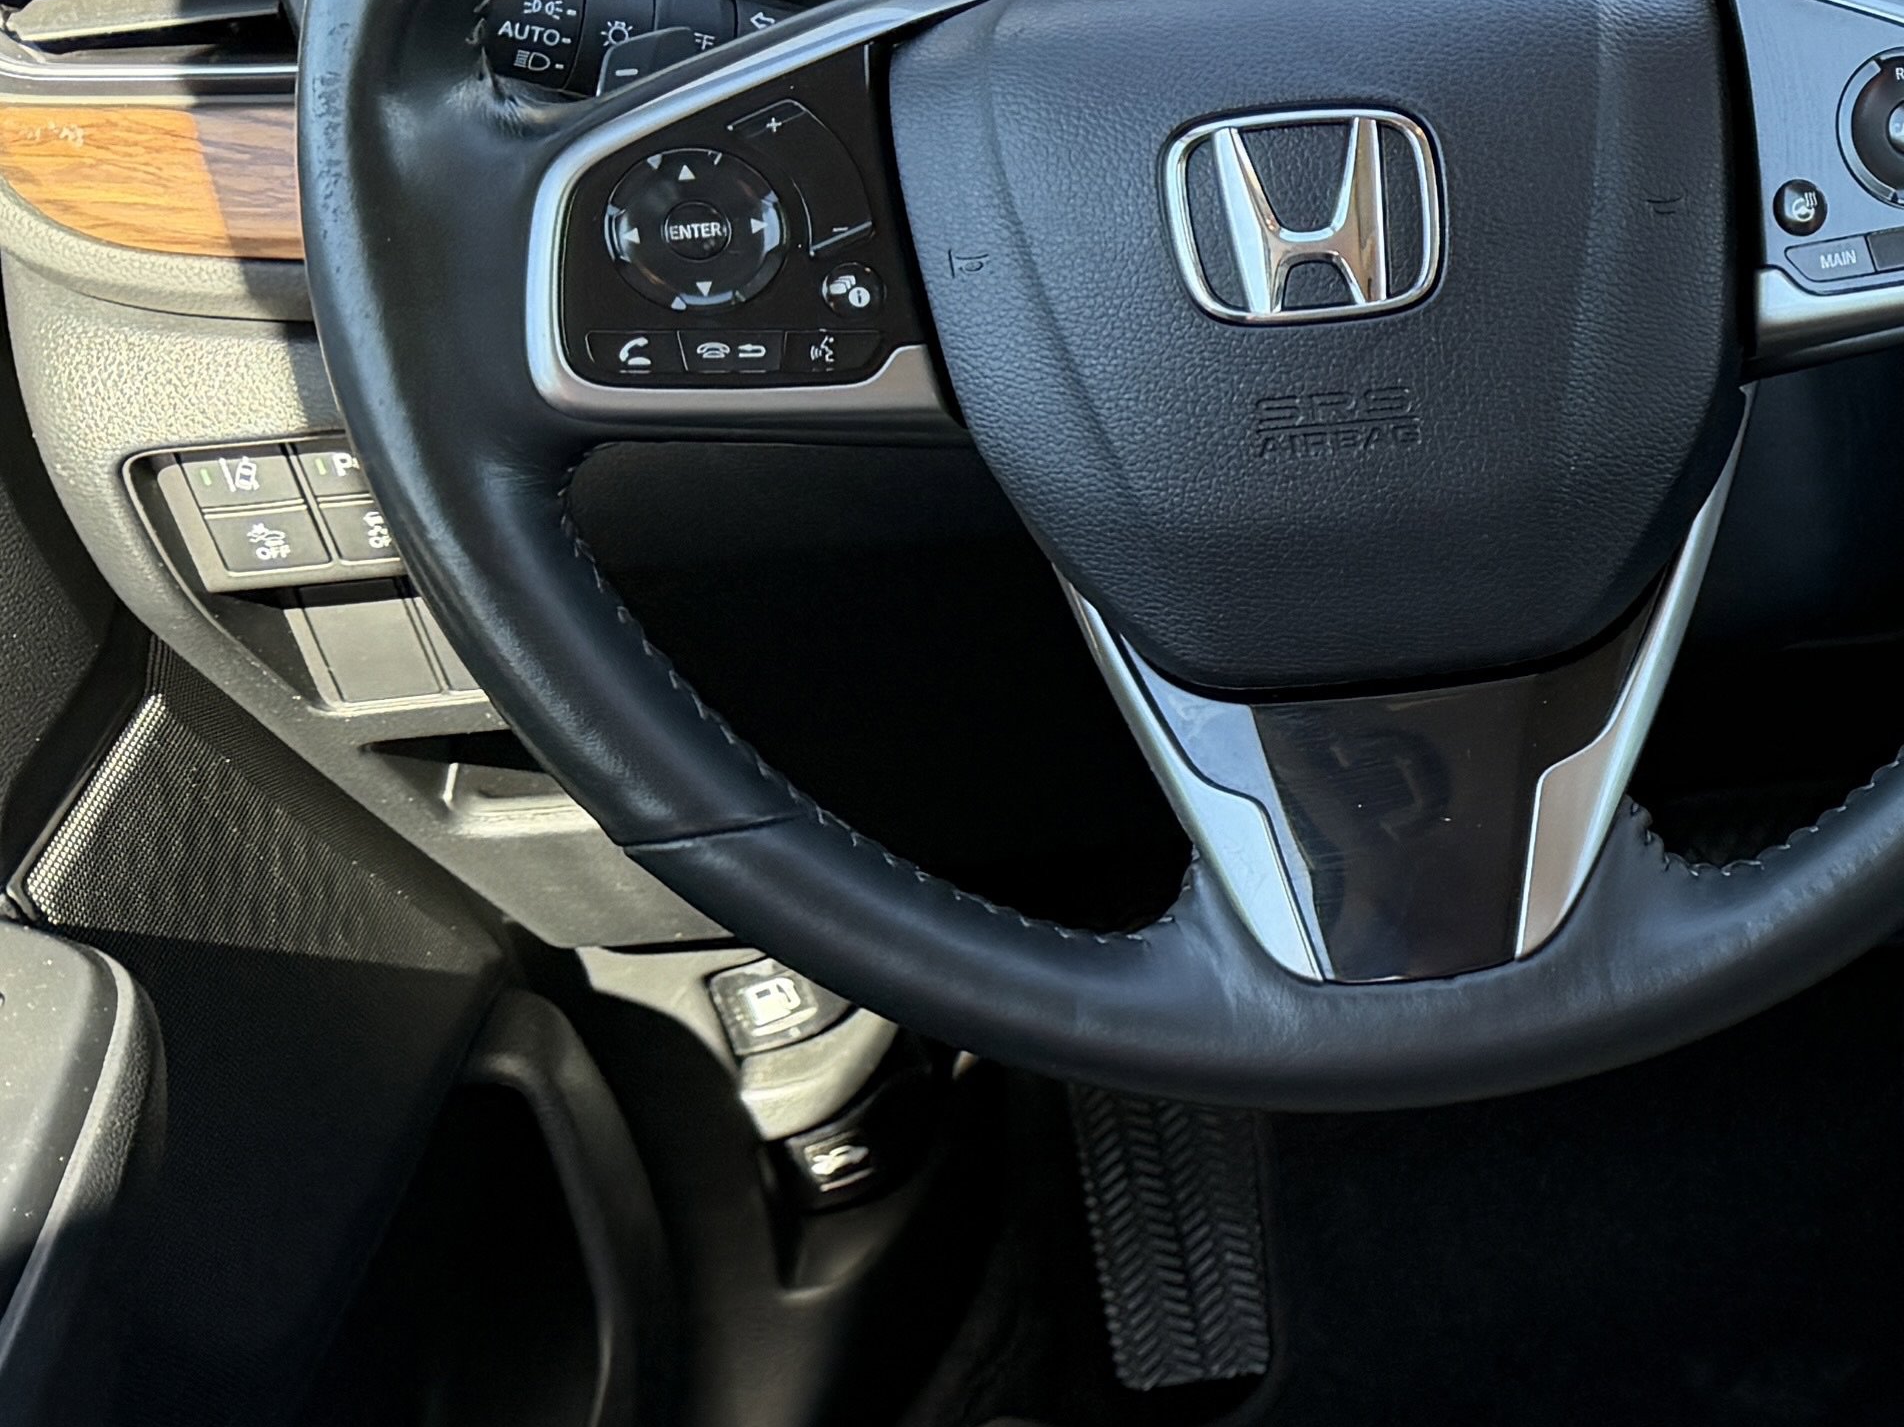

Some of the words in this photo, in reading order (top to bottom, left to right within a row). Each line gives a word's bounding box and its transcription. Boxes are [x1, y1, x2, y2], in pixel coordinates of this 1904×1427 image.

[497, 21, 560, 46] AUTO
[669, 222, 722, 240] ENTER
[1819, 250, 1857, 269] MAIN
[256, 544, 291, 561] OFF
